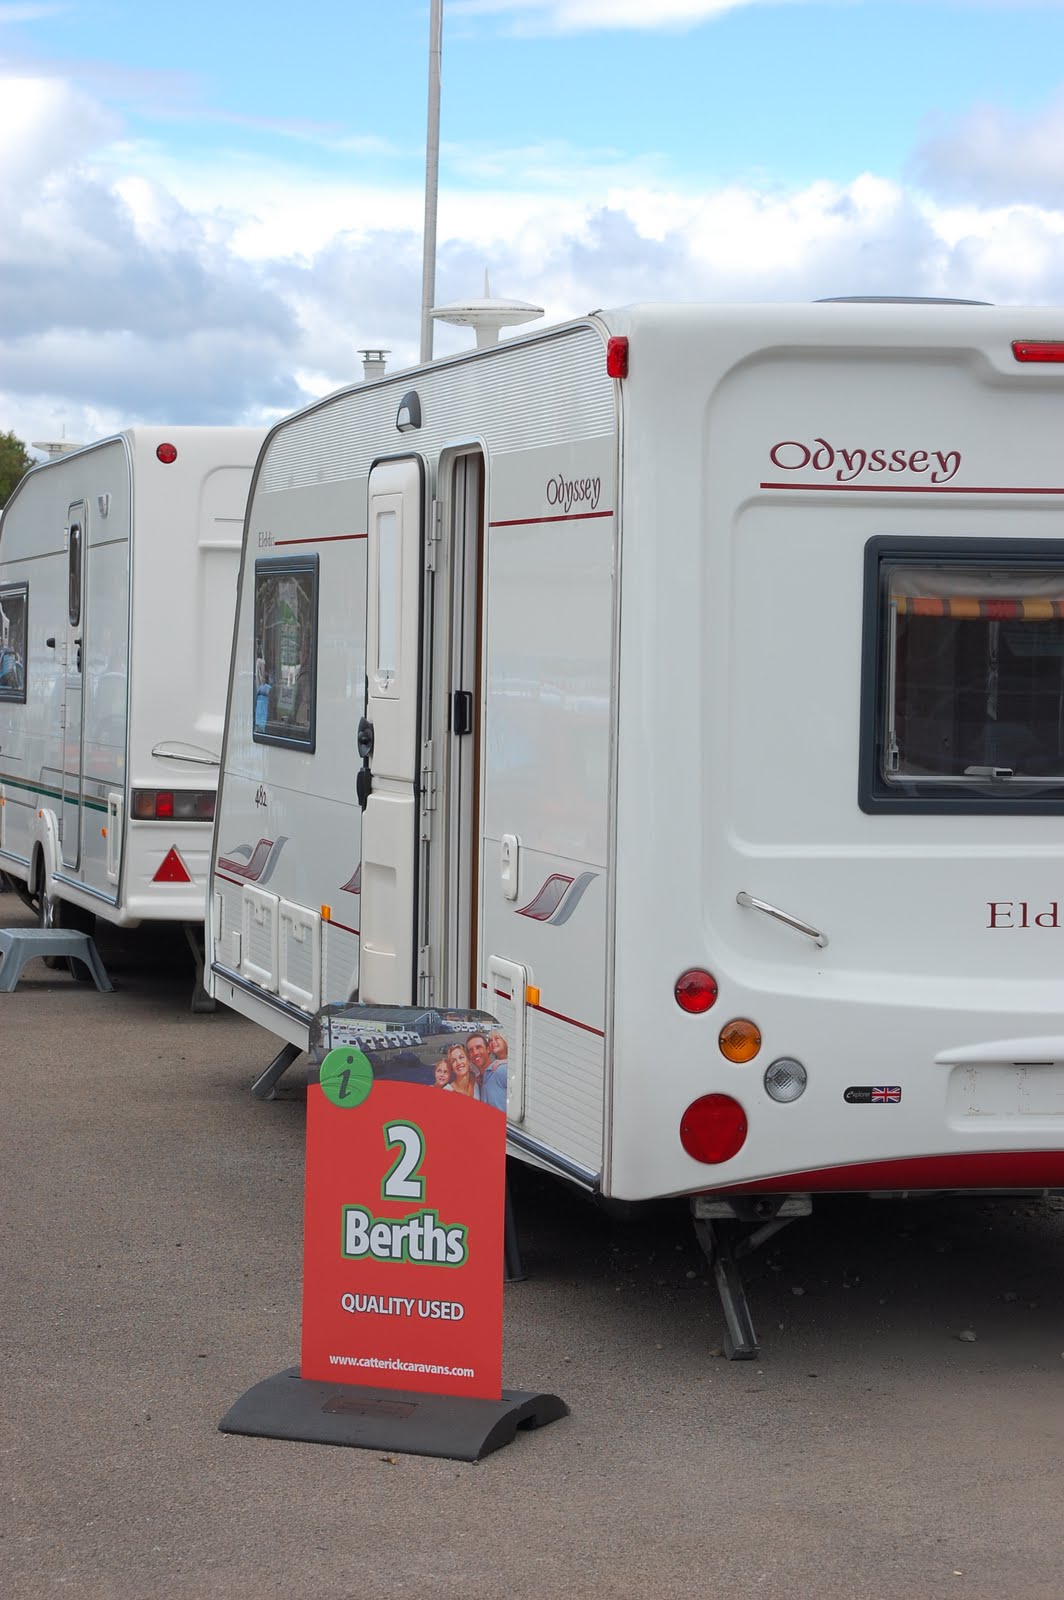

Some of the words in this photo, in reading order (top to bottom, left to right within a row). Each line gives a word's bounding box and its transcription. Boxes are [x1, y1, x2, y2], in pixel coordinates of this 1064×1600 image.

[769, 437, 962, 484] Odyssey
[546, 474, 601, 513] Odyssey
[255, 785, 267, 808] 482
[986, 902, 1062, 928] Eld
[846, 1090, 871, 1099] explorer
[384, 1123, 423, 1200] 2
[343, 1207, 466, 1265] Berths
[341, 1292, 415, 1316] QUALITY
[418, 1299, 465, 1321] USED
[329, 1354, 475, 1378] www.catterickcaravans.com
